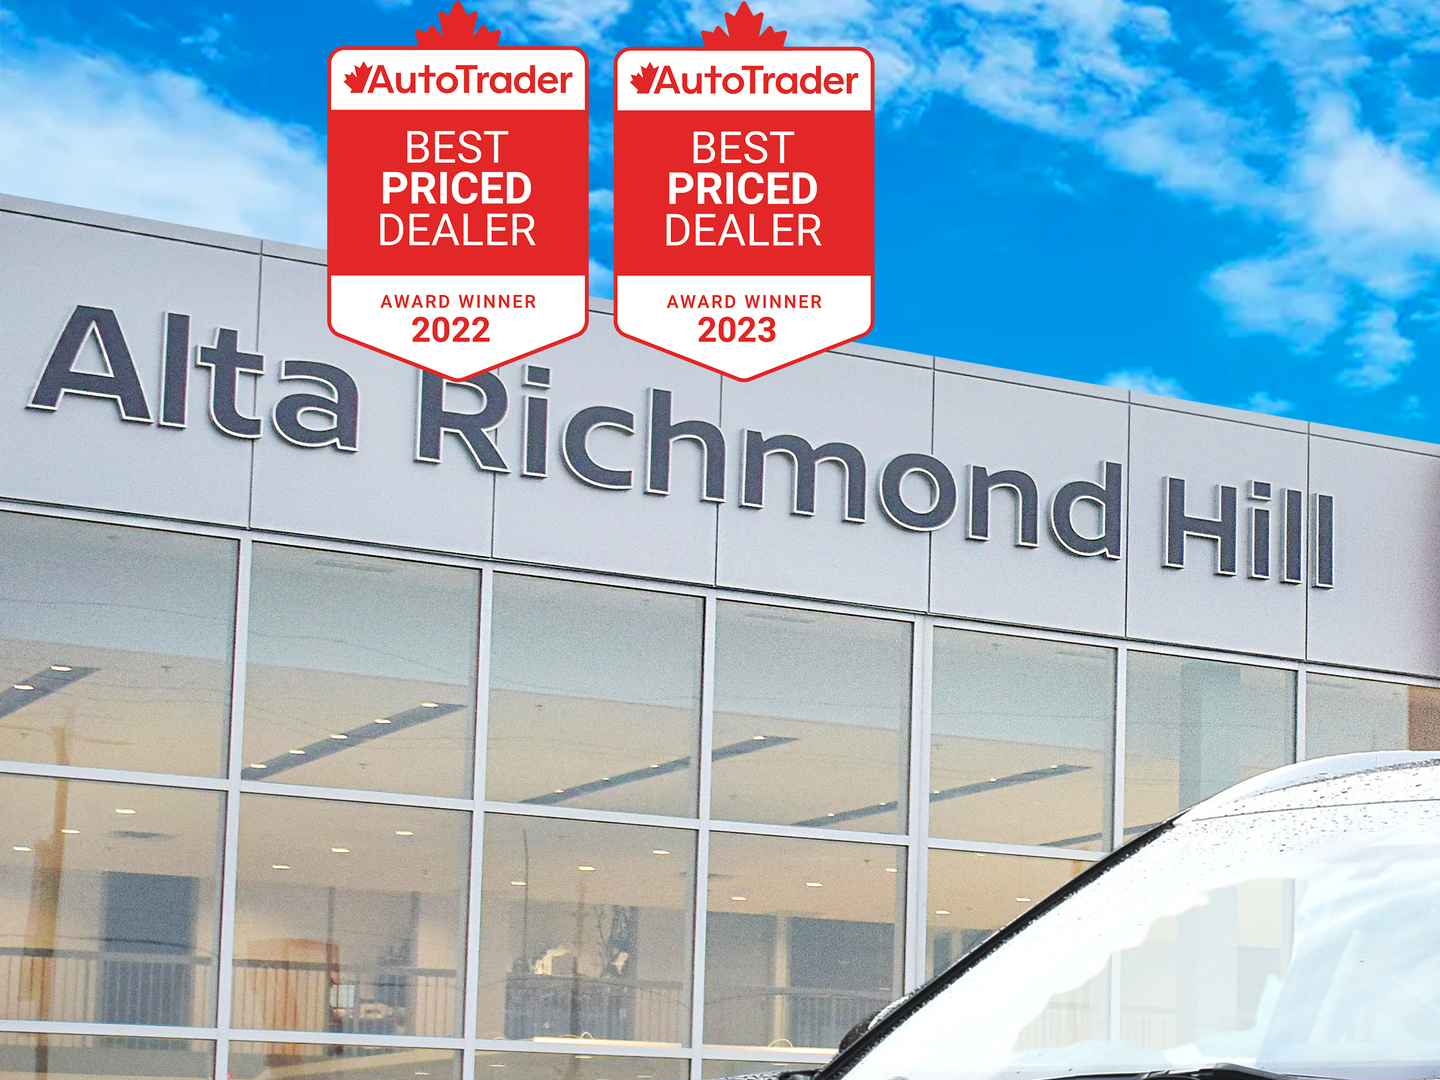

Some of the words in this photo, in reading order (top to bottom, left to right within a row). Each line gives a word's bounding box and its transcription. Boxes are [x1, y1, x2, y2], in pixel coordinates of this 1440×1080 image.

[25, 304, 361, 453] Alta
[414, 364, 1123, 560] Richmond
[1161, 475, 1335, 588] Hill
